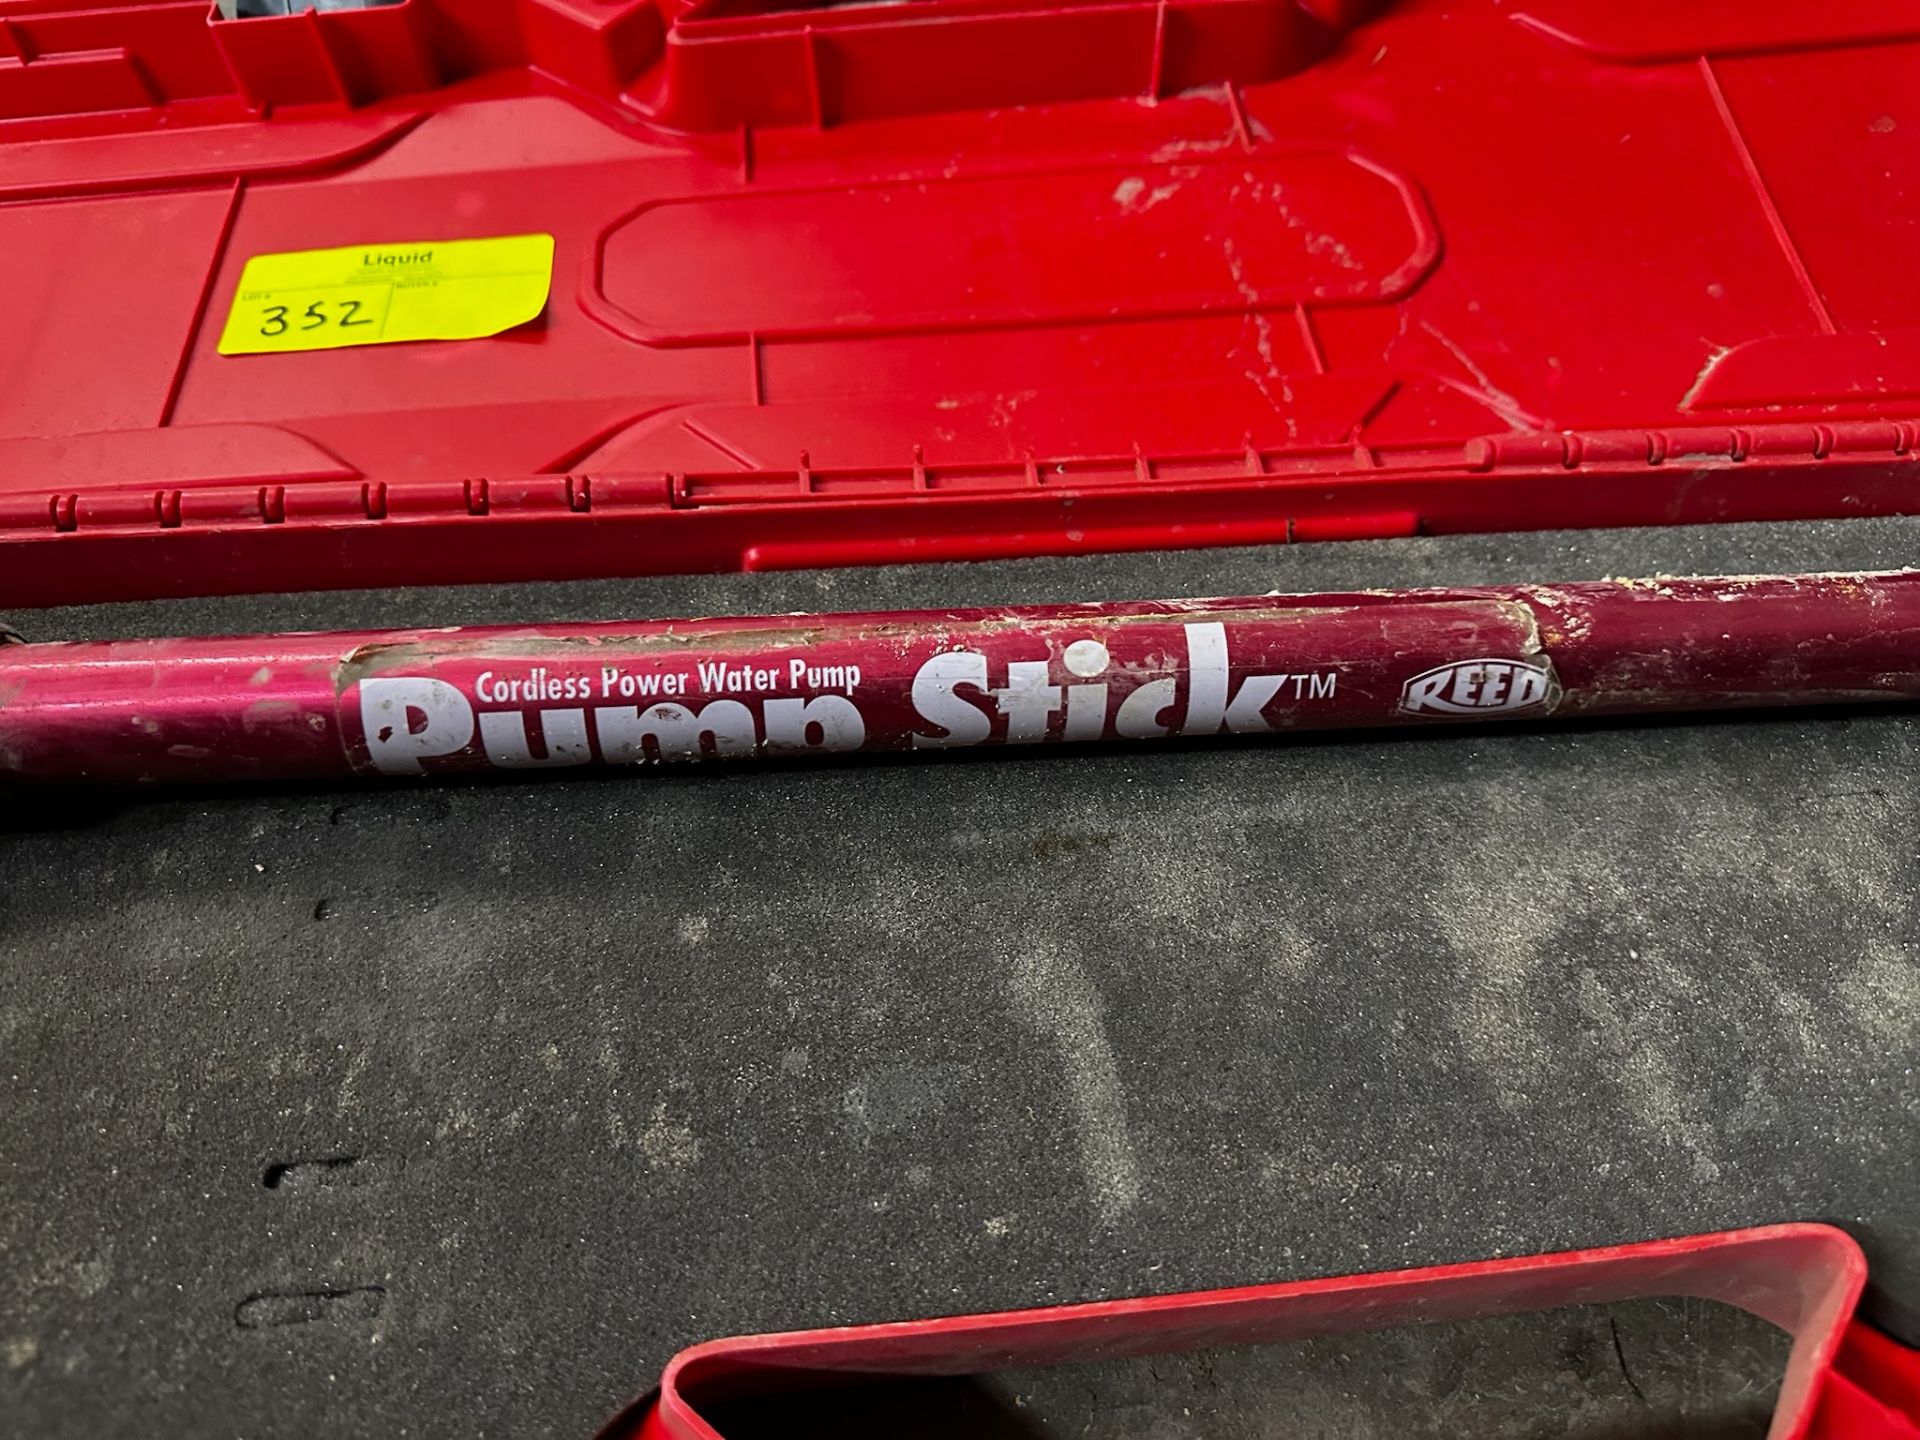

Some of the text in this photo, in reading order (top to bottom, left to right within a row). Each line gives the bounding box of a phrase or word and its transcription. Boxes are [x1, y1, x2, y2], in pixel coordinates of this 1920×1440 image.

[363, 250, 433, 268] Liquid
[260, 300, 374, 337] 352
[359, 677, 866, 776] Pump
[911, 621, 1289, 750] Stick
[476, 658, 861, 703] Cordless Power Water Pump
[1406, 663, 1548, 713] REED
